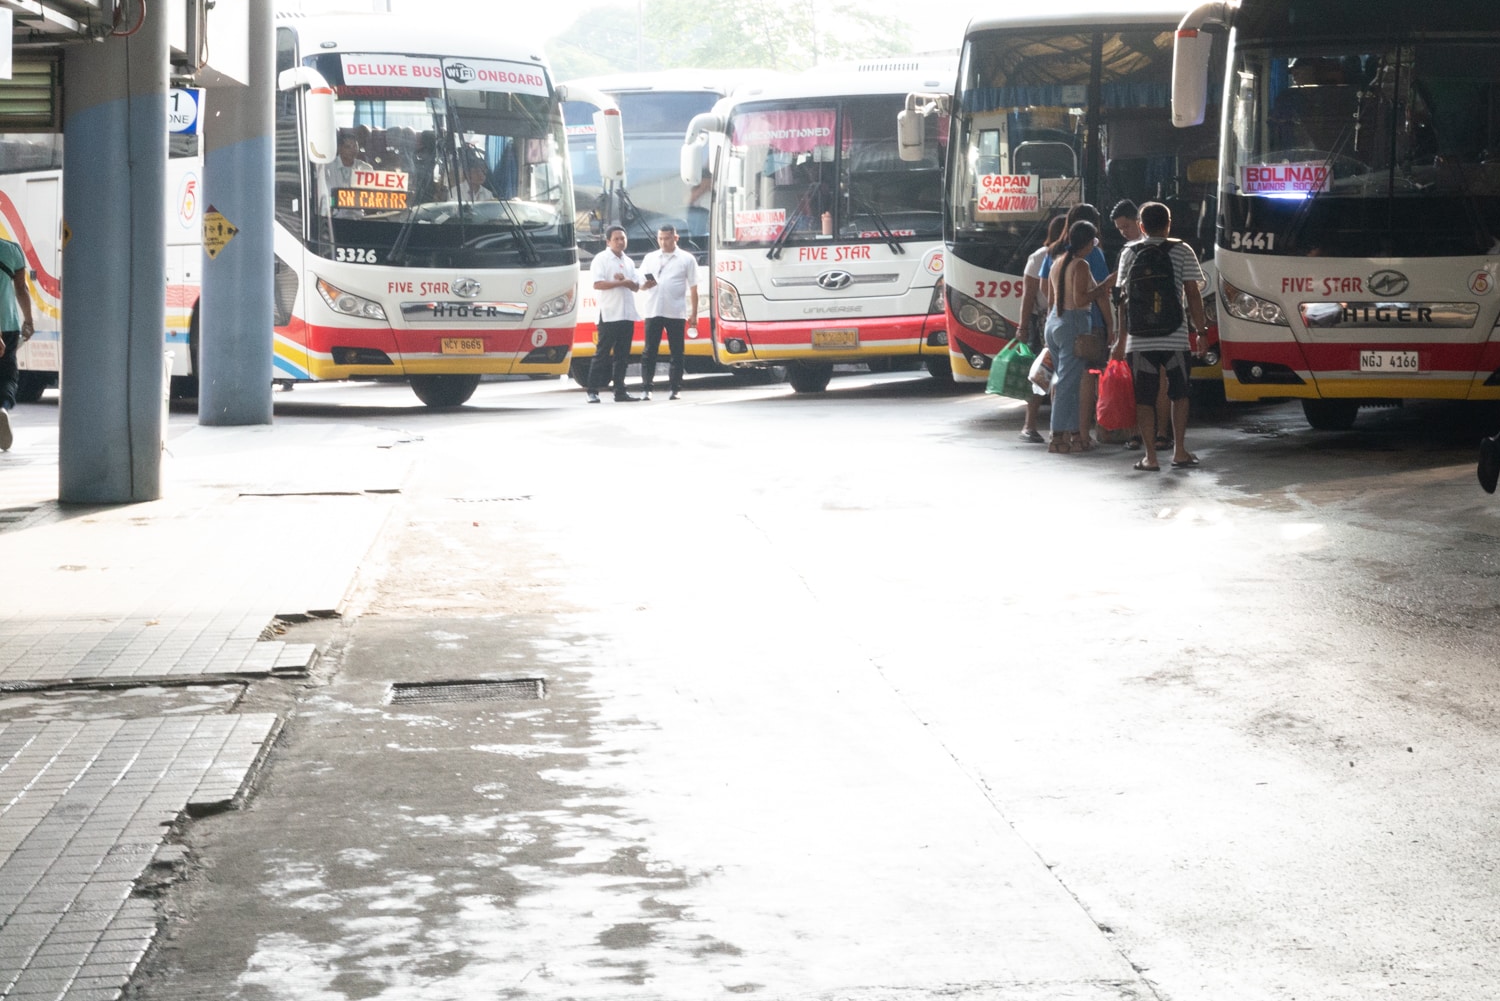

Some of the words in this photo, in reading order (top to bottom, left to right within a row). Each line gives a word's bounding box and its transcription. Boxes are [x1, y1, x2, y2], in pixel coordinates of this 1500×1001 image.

[347, 63, 408, 77] DELUXE
[412, 65, 442, 79] BUS
[478, 70, 543, 87] ONBOARD
[355, 171, 405, 189] TPLEX
[982, 175, 1031, 188] GAPAN
[1246, 167, 1327, 182] BOLINAO
[1231, 231, 1275, 250] 3441
[336, 247, 378, 264] 3326
[799, 247, 828, 262] FIVE
[834, 246, 871, 262] STAR
[388, 282, 414, 294] FIVE
[419, 281, 450, 297] STAR
[974, 280, 1024, 298] 3299
[1281, 277, 1314, 294] FIVE
[1322, 277, 1363, 296] STAR
[433, 306, 498, 318] HIGER
[803, 305, 863, 314] UNIVERSE
[1343, 307, 1433, 323] HIGER
[1361, 355, 1383, 368] NGJ
[1389, 355, 1417, 368] 4166
